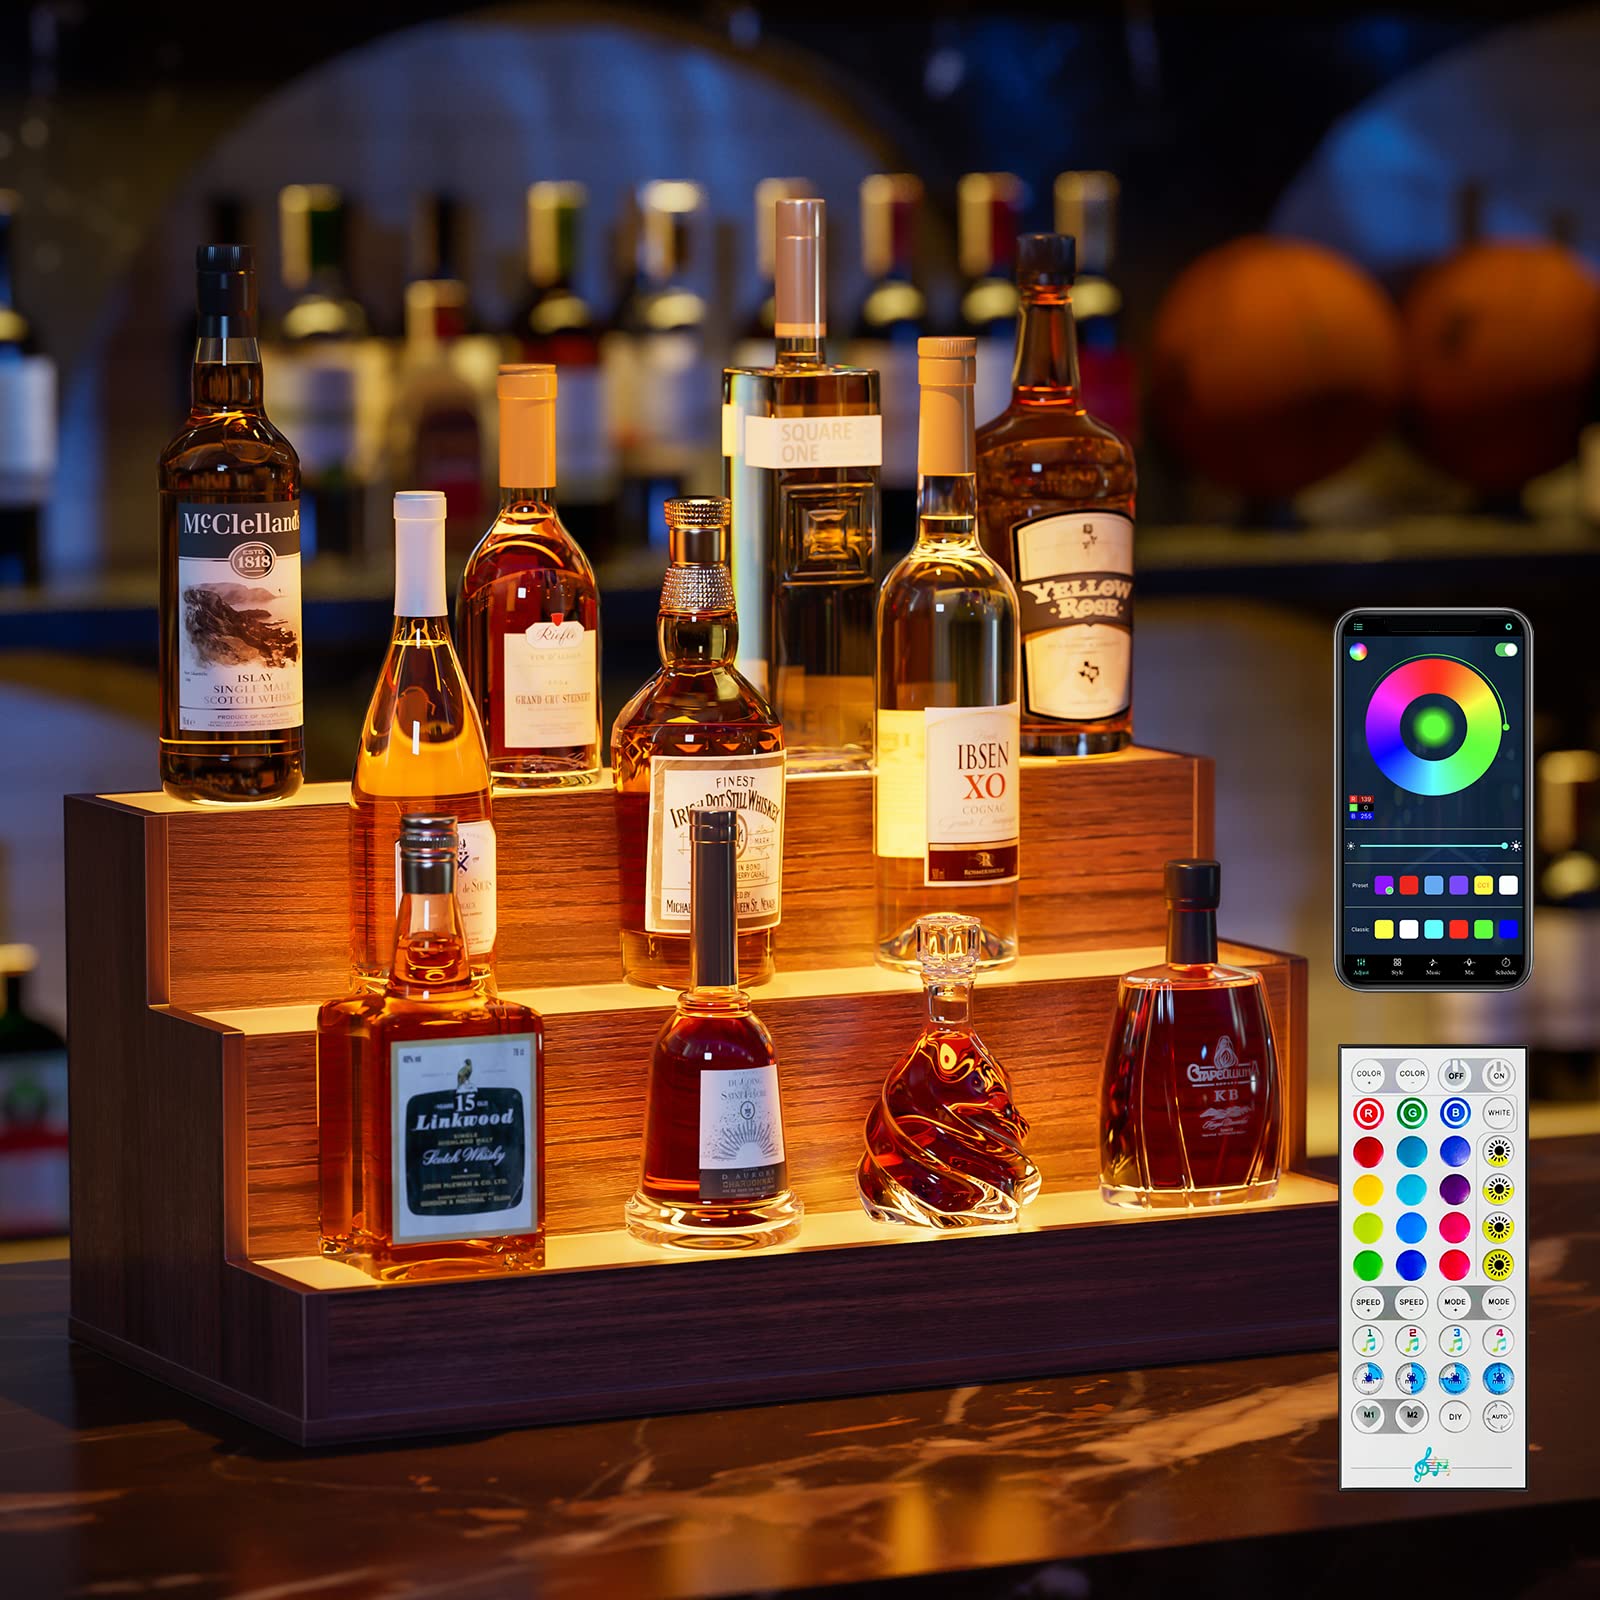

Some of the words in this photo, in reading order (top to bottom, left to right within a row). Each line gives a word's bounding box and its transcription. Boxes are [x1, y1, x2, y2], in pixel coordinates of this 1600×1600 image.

[781, 422, 854, 442] SQUARE
[782, 444, 820, 463] ONE
[237, 555, 271, 569] 1818
[1021, 579, 1133, 605] YELLOW
[1056, 598, 1120, 619] ROSE
[237, 673, 274, 683] ISLAY
[213, 685, 257, 693] SINGLE
[203, 695, 255, 705] SCOTCH
[515, 695, 541, 705] GRAND
[957, 742, 1010, 770] IBSEN
[716, 775, 756, 789] FINEST
[963, 772, 1006, 800] XO
[726, 789, 748, 809] STILL
[748, 788, 781, 824] WHISKEY
[962, 802, 1006, 815] COGNAC
[1399, 1069, 1426, 1077] COLOR
[1448, 1072, 1465, 1080] OFF
[1493, 1072, 1505, 1080] ON
[455, 1094, 476, 1112] 15
[1364, 1109, 1373, 1118] R
[1408, 1108, 1418, 1118] G
[1452, 1108, 1460, 1118] B
[1487, 1109, 1511, 1117] WHITE
[412, 1108, 515, 1132] Linkwood
[422, 1149, 463, 1167] Scotch
[462, 1145, 506, 1167] Whisky
[1356, 1298, 1381, 1306] SPEED
[1399, 1298, 1425, 1306] SPEED
[1444, 1298, 1466, 1306] MODE
[1367, 1328, 1373, 1337] 1
[1409, 1328, 1417, 1337] 2
[1453, 1328, 1461, 1337] 3
[1496, 1328, 1504, 1337] 4
[1363, 1411, 1375, 1419] M1
[1406, 1411, 1418, 1419] M2
[1448, 1413, 1462, 1421] DIY
